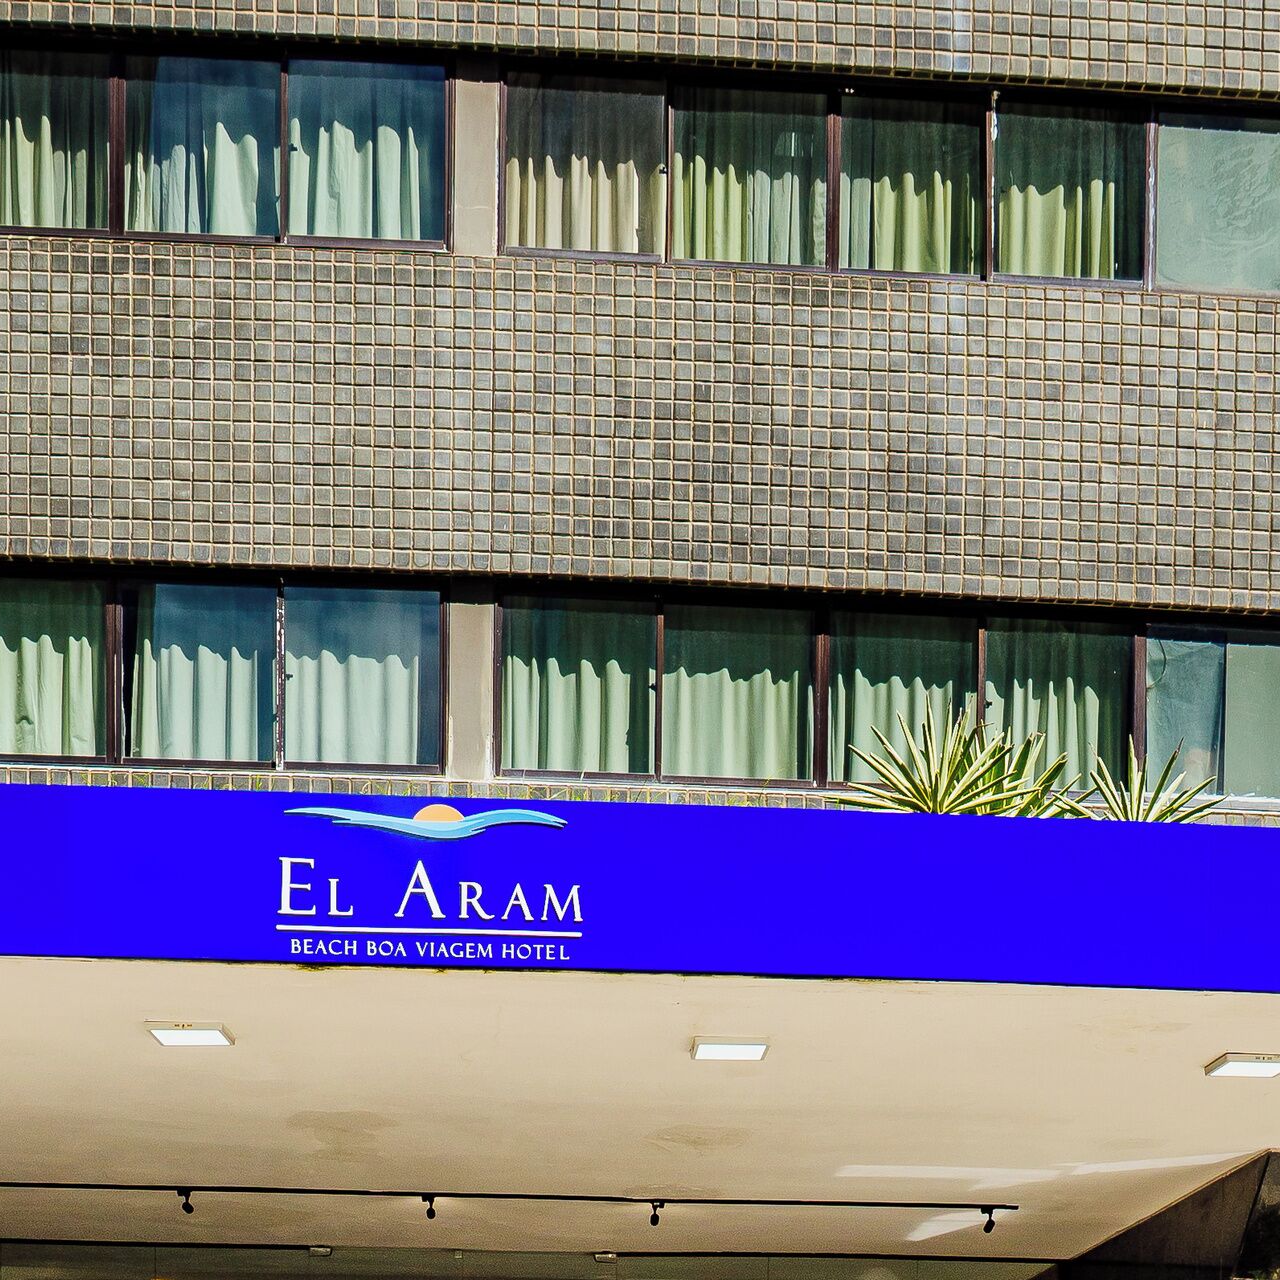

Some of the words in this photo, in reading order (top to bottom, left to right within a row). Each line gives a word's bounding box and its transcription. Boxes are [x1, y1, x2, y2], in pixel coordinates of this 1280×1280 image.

[276, 856, 354, 916] EL
[393, 859, 584, 922] ARAM
[290, 938, 358, 956] BEACH
[366, 940, 407, 957] BOA
[415, 941, 493, 959] VIAGEM
[501, 943, 570, 961] HOTEL
